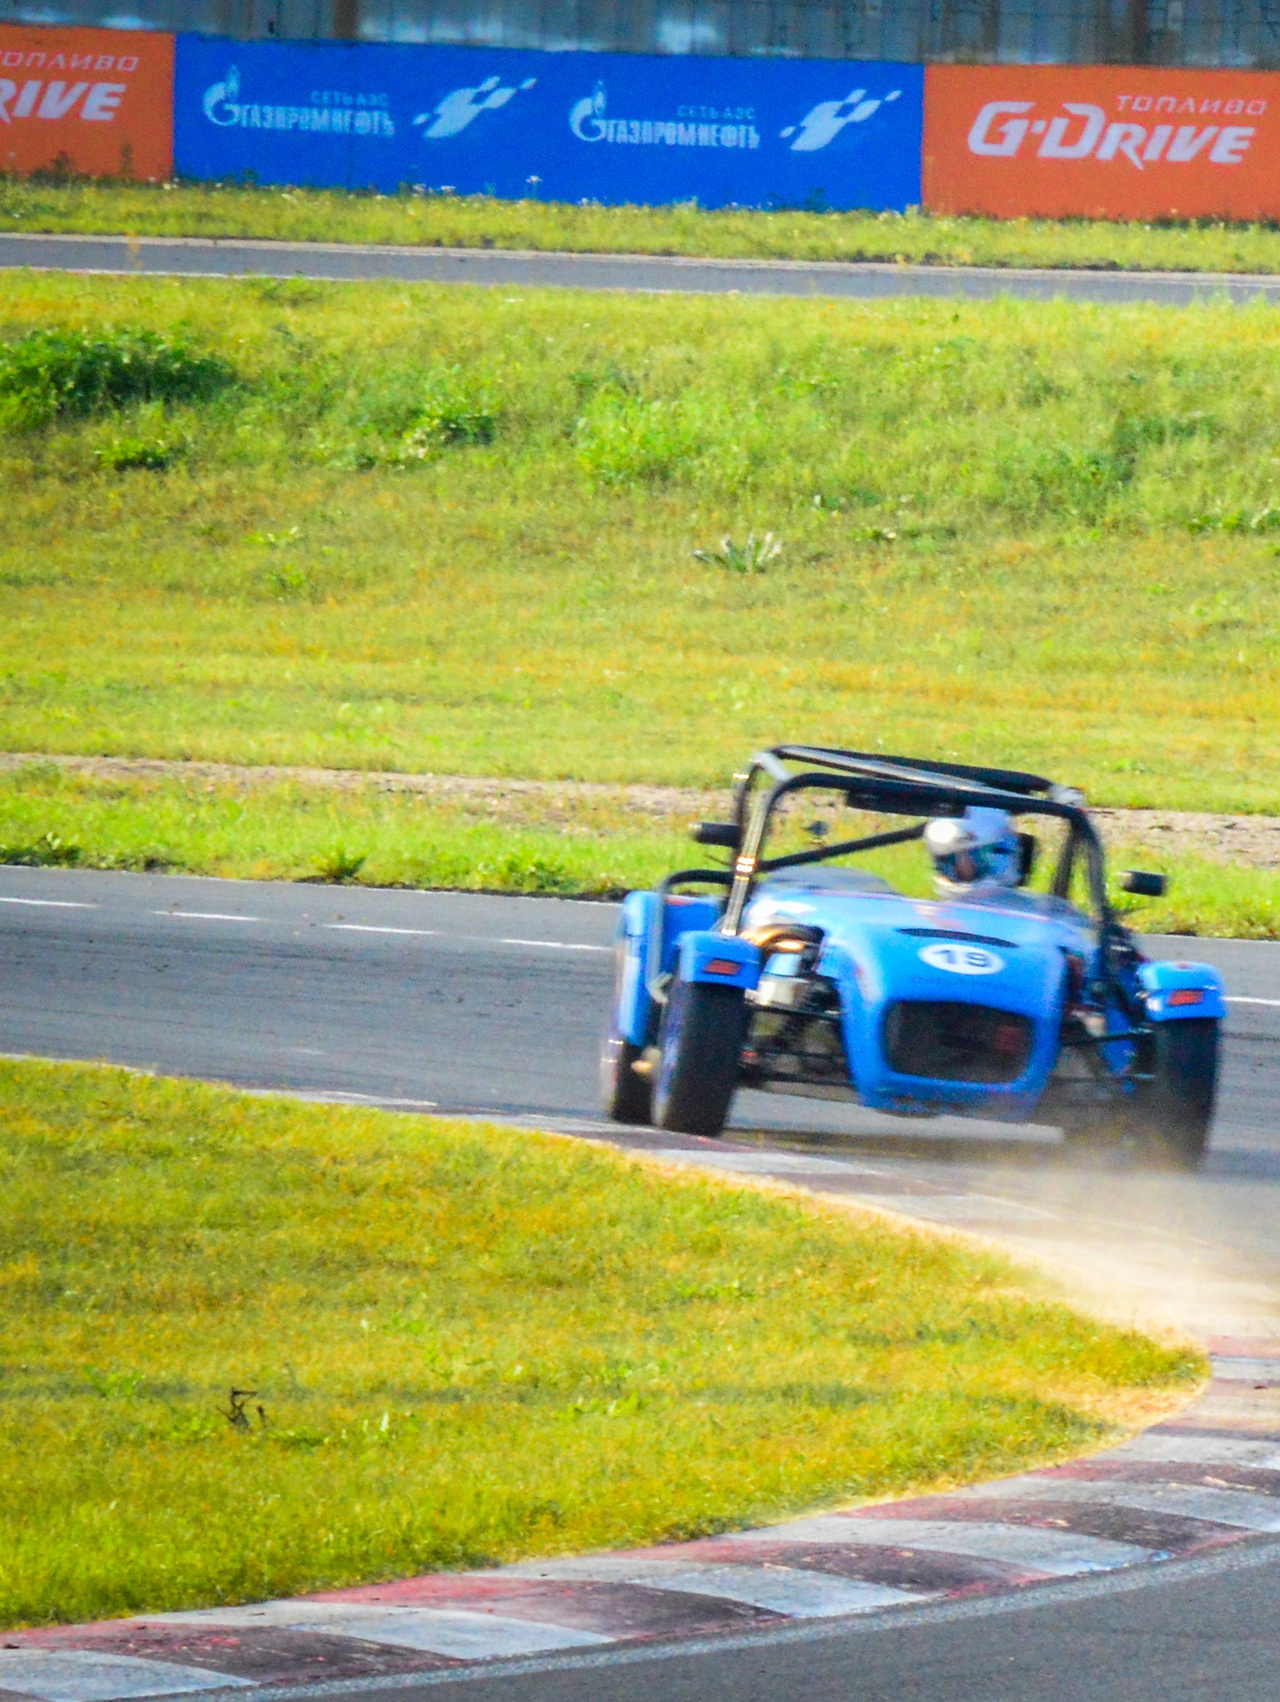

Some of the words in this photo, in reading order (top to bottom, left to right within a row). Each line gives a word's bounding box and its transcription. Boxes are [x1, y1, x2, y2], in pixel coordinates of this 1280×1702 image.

[0, 52, 139, 71] ОПЛИВО
[1116, 95, 1268, 116] ТОПЛИВО
[241, 104, 396, 137] ГАЗПРОМНЕФТЬ
[607, 120, 760, 149] ГАЗПРОМНЕФТЬ
